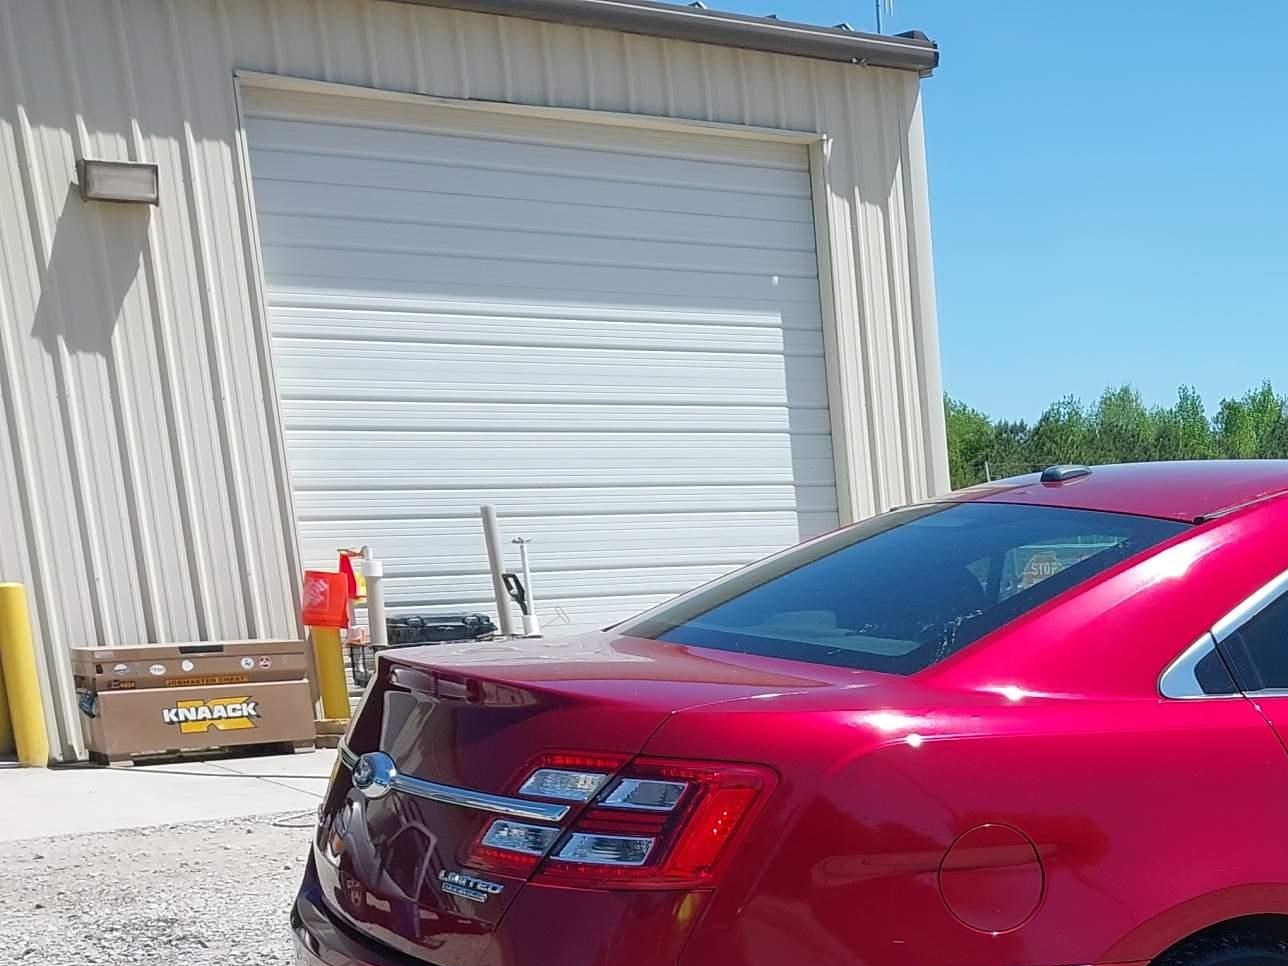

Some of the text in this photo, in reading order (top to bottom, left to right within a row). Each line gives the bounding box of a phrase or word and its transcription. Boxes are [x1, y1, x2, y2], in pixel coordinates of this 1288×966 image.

[1031, 562, 1059, 575] STOP
[162, 701, 258, 723] KNAACK
[438, 869, 504, 894] LIMITED
